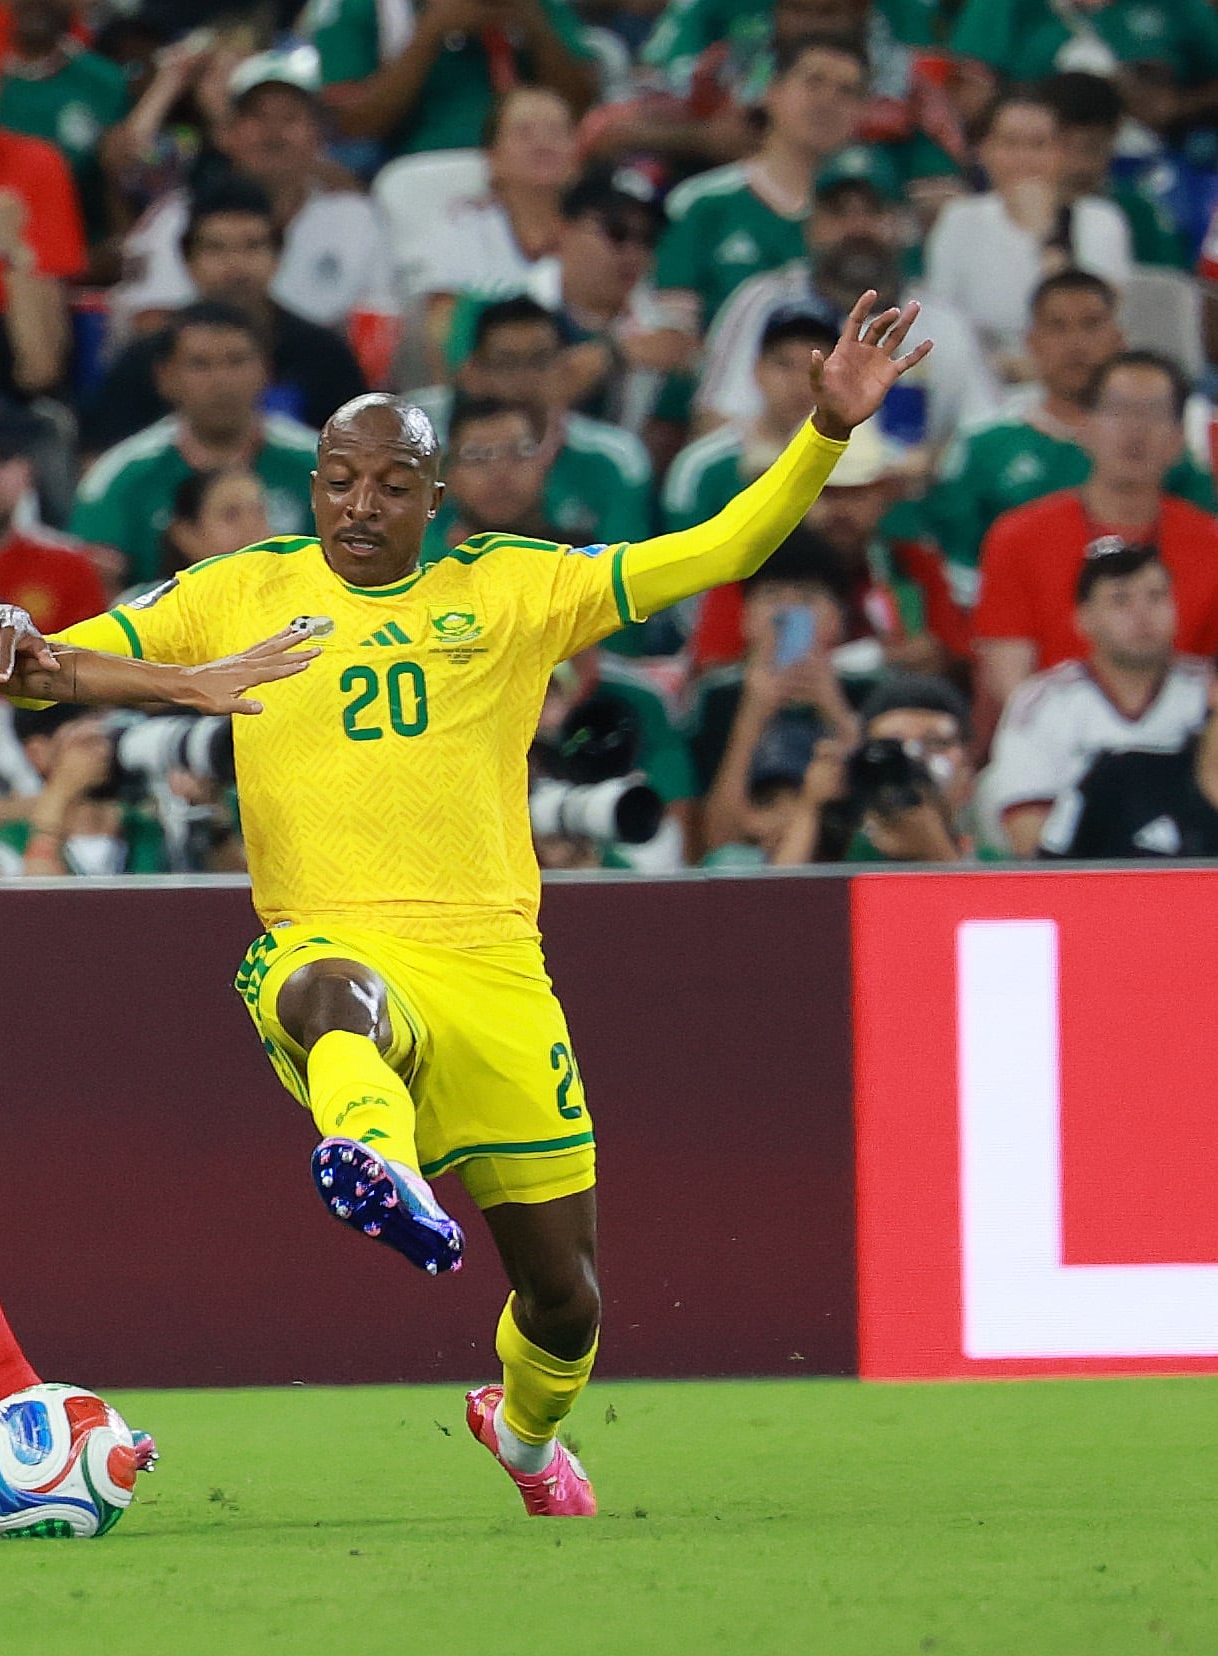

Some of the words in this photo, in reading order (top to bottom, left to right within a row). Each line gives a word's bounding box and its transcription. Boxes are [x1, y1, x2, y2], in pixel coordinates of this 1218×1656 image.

[340, 661, 428, 741] 20
[335, 1095, 390, 1128] SAFA
[550, 1042, 583, 1120] 2
